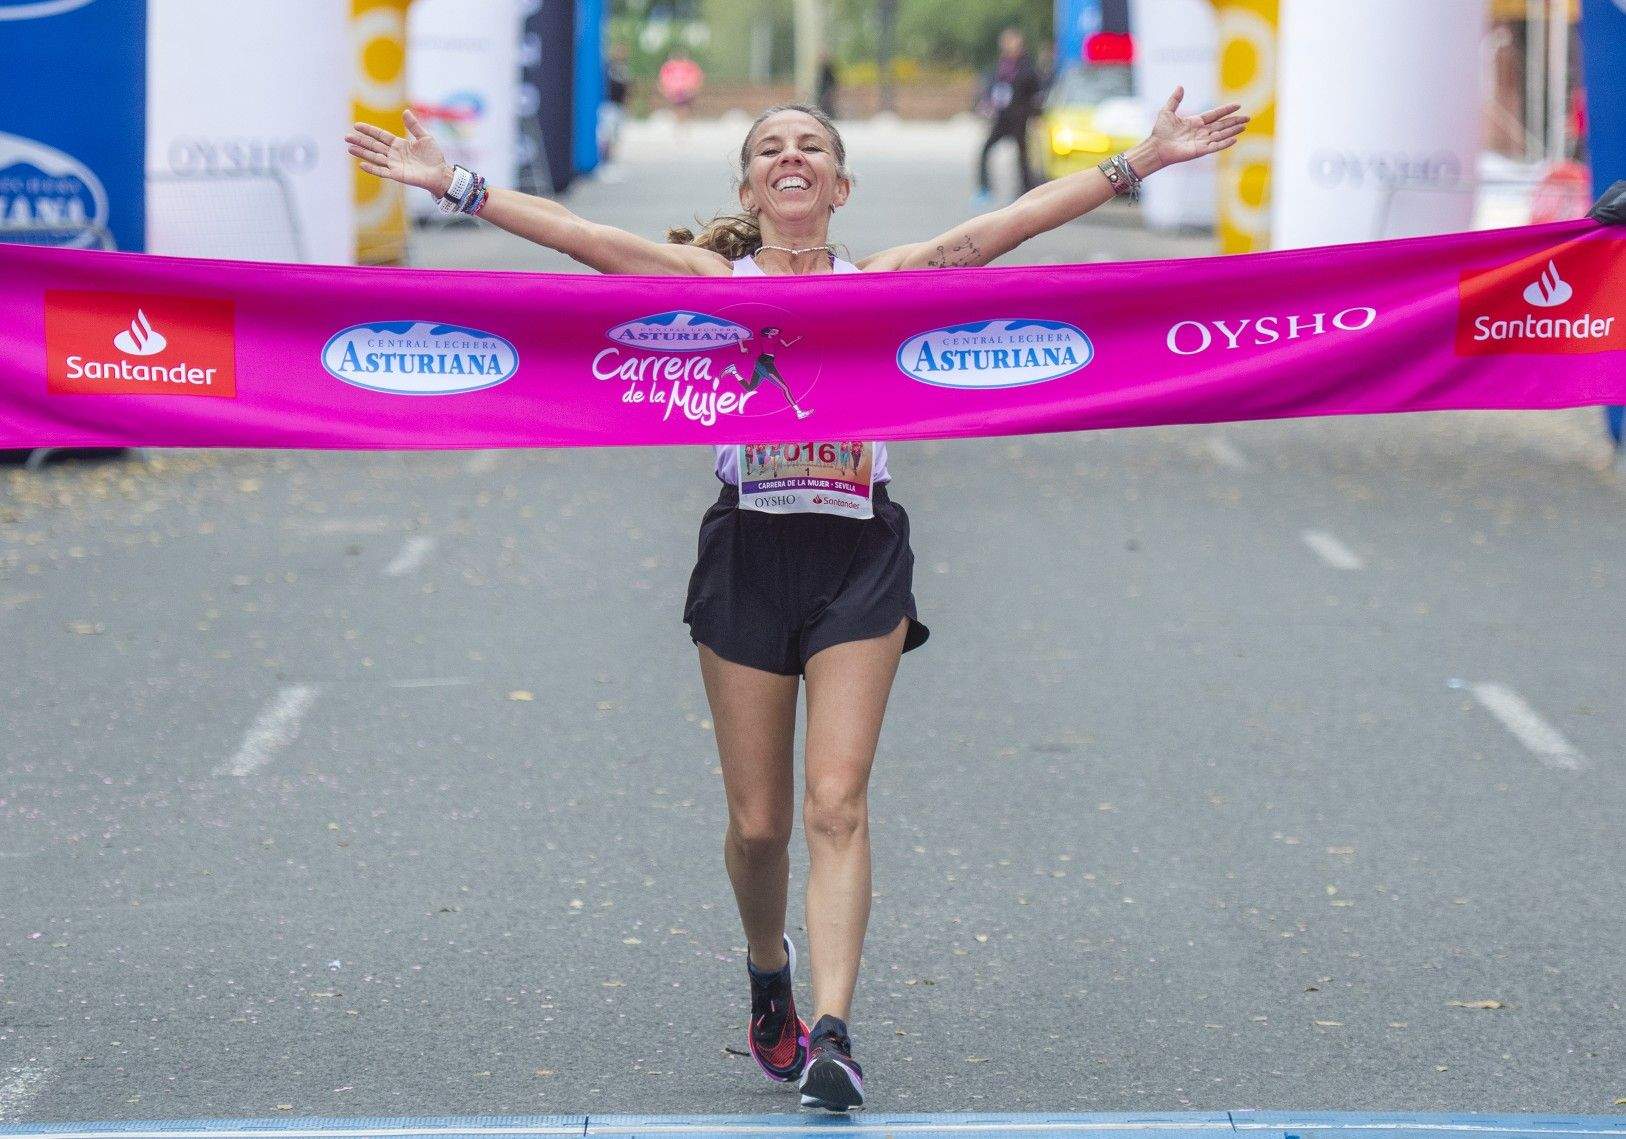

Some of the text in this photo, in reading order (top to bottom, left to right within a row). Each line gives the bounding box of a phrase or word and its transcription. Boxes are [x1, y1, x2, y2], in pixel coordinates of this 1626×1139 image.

[617, 328, 741, 341] ASTURIANA
[1166, 307, 1377, 355] OYSHO
[1473, 313, 1615, 341] Santander
[367, 339, 498, 349] CENTRAL LECHERA
[943, 333, 1072, 346] CENTRAL LECHERA
[337, 340, 504, 376] ASTURIANA
[592, 347, 713, 382] Carrera
[913, 340, 1079, 372] ASTURIANA
[65, 355, 217, 385] Santander
[621, 377, 759, 427] de la Mujer
[804, 467, 811, 477] 1
[758, 480, 787, 490] CARRERA
[787, 479, 797, 487] DE
[797, 479, 806, 487] LA
[807, 479, 830, 488] MUJER
[835, 481, 856, 493] SEVILLA
[754, 494, 796, 508] OYSHO
[823, 496, 860, 510] Santander
